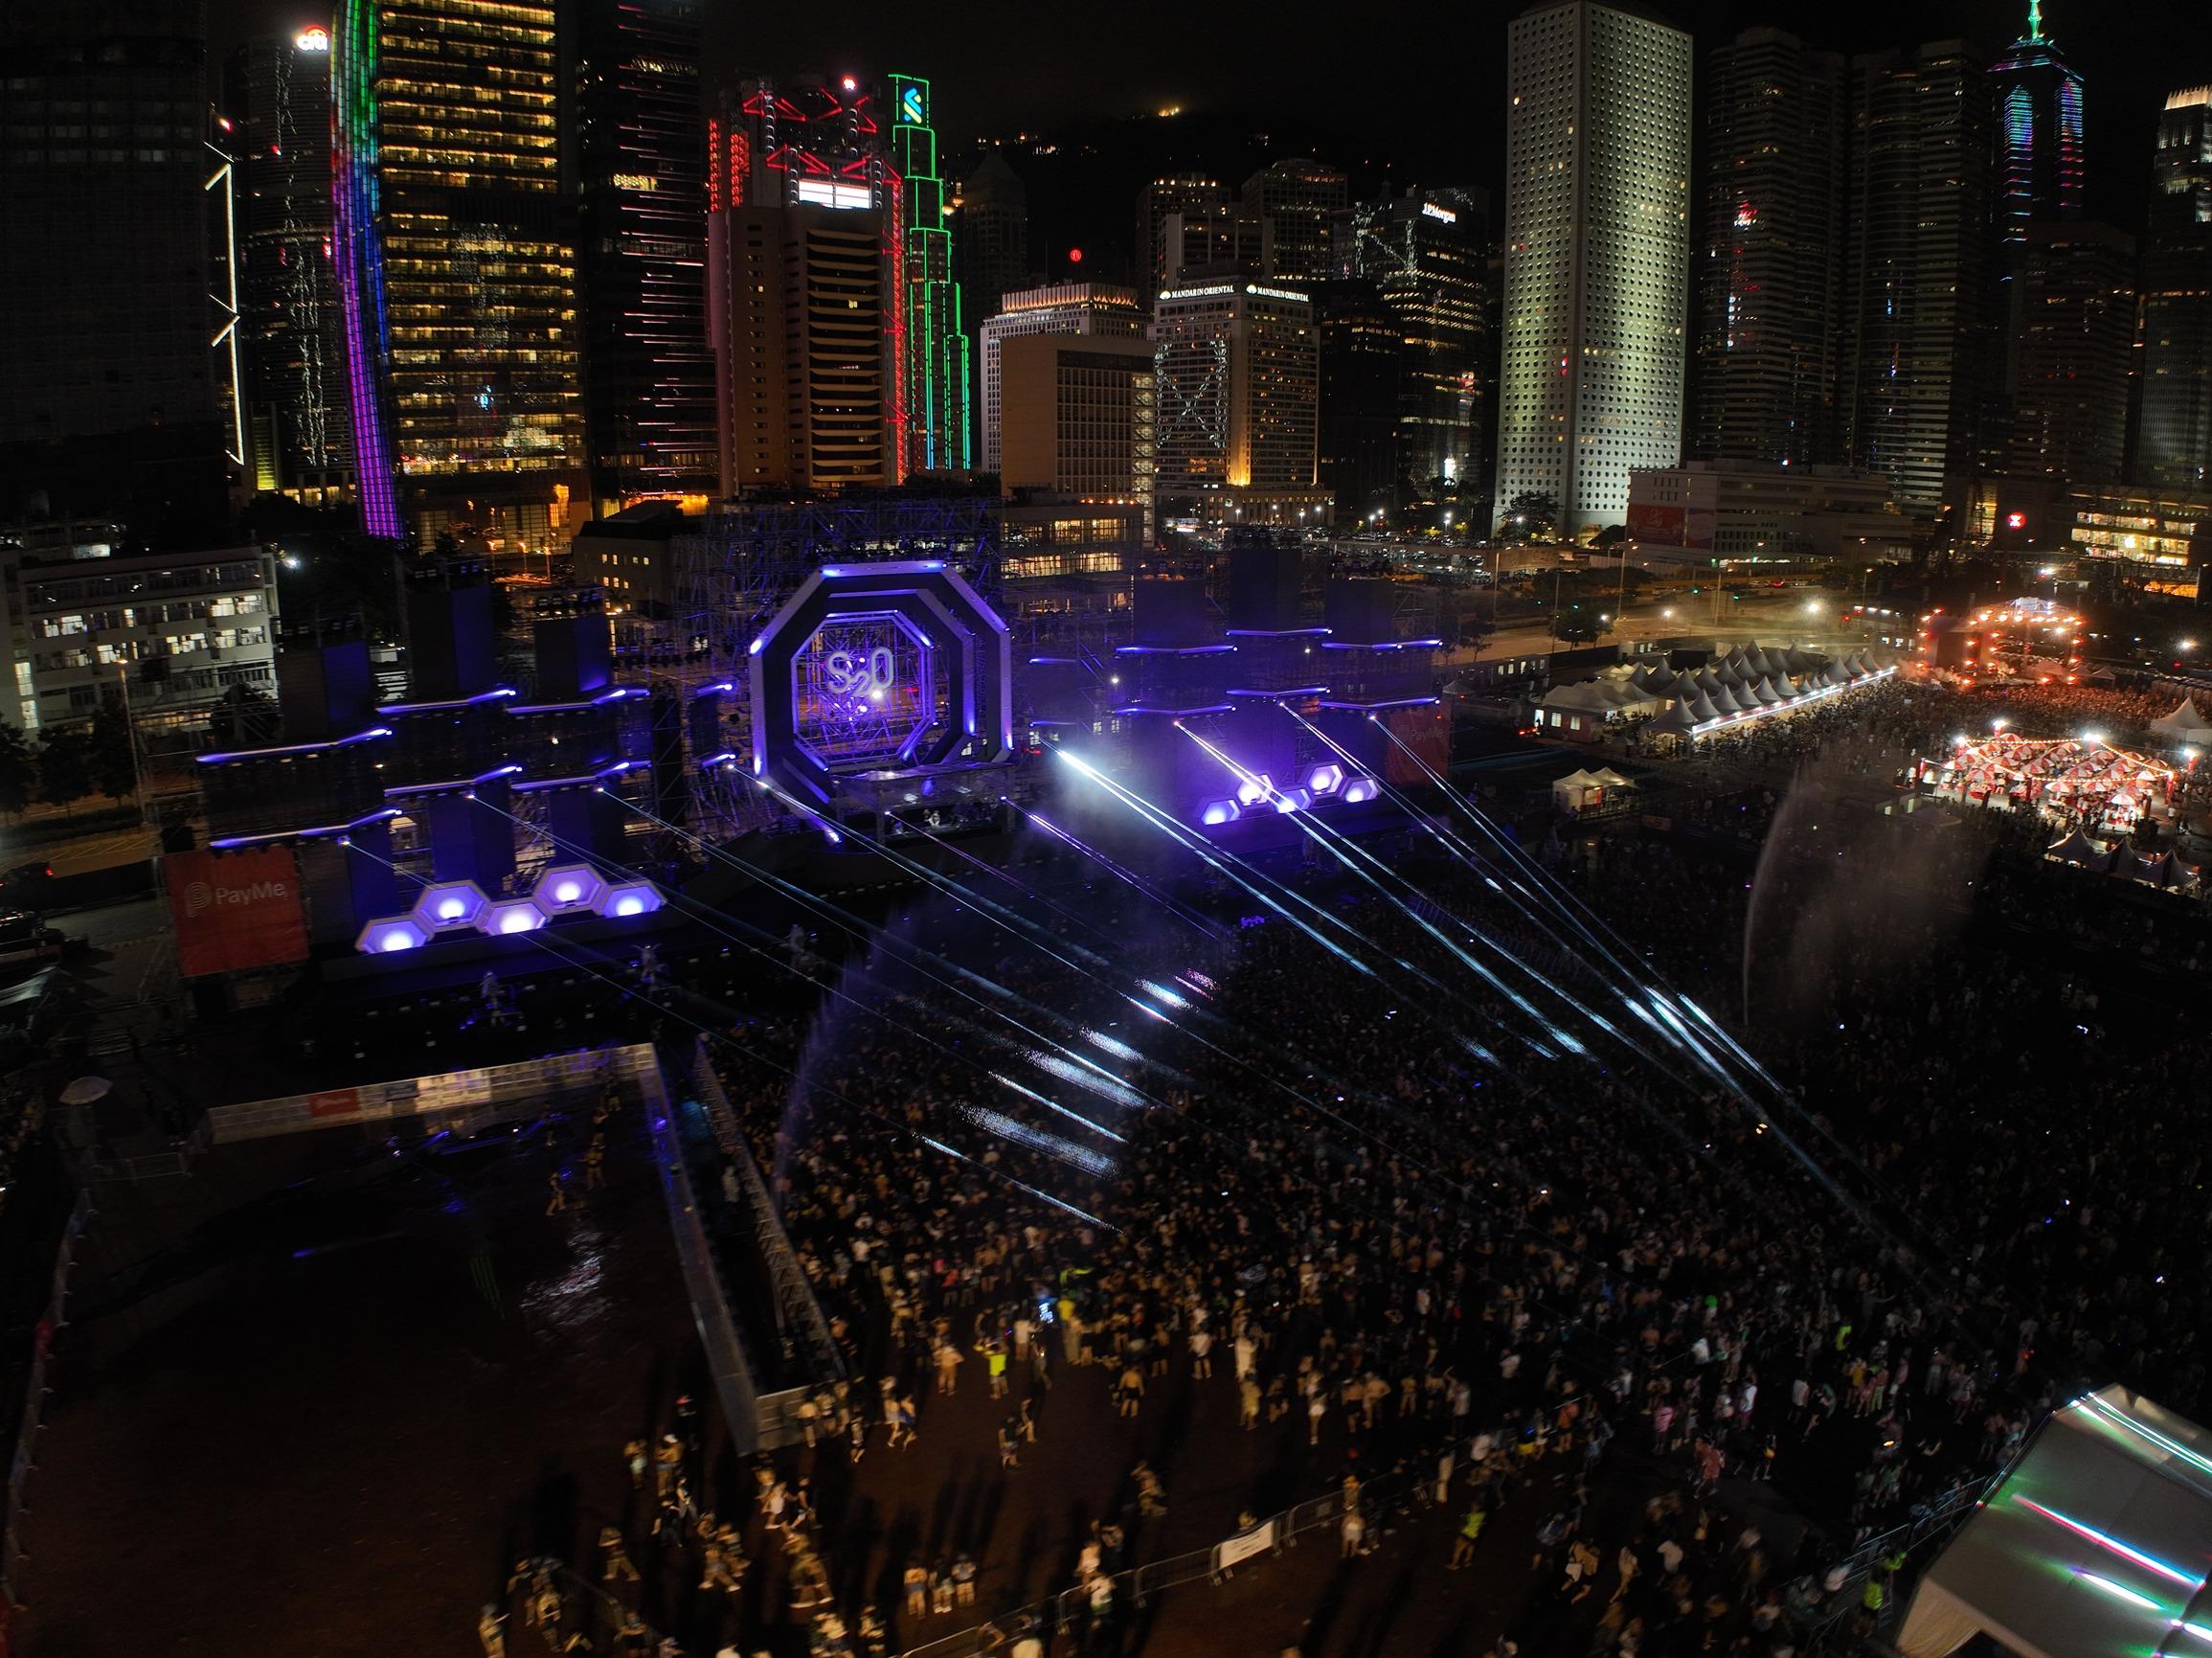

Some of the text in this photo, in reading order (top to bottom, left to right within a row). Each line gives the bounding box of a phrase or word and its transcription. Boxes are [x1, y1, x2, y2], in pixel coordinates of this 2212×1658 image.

[1171, 284, 1234, 299] MANDARIN ORIENTAL
[1257, 286, 1309, 302] MANDARIN ORIENTAL
[214, 880, 285, 905] PayMe
